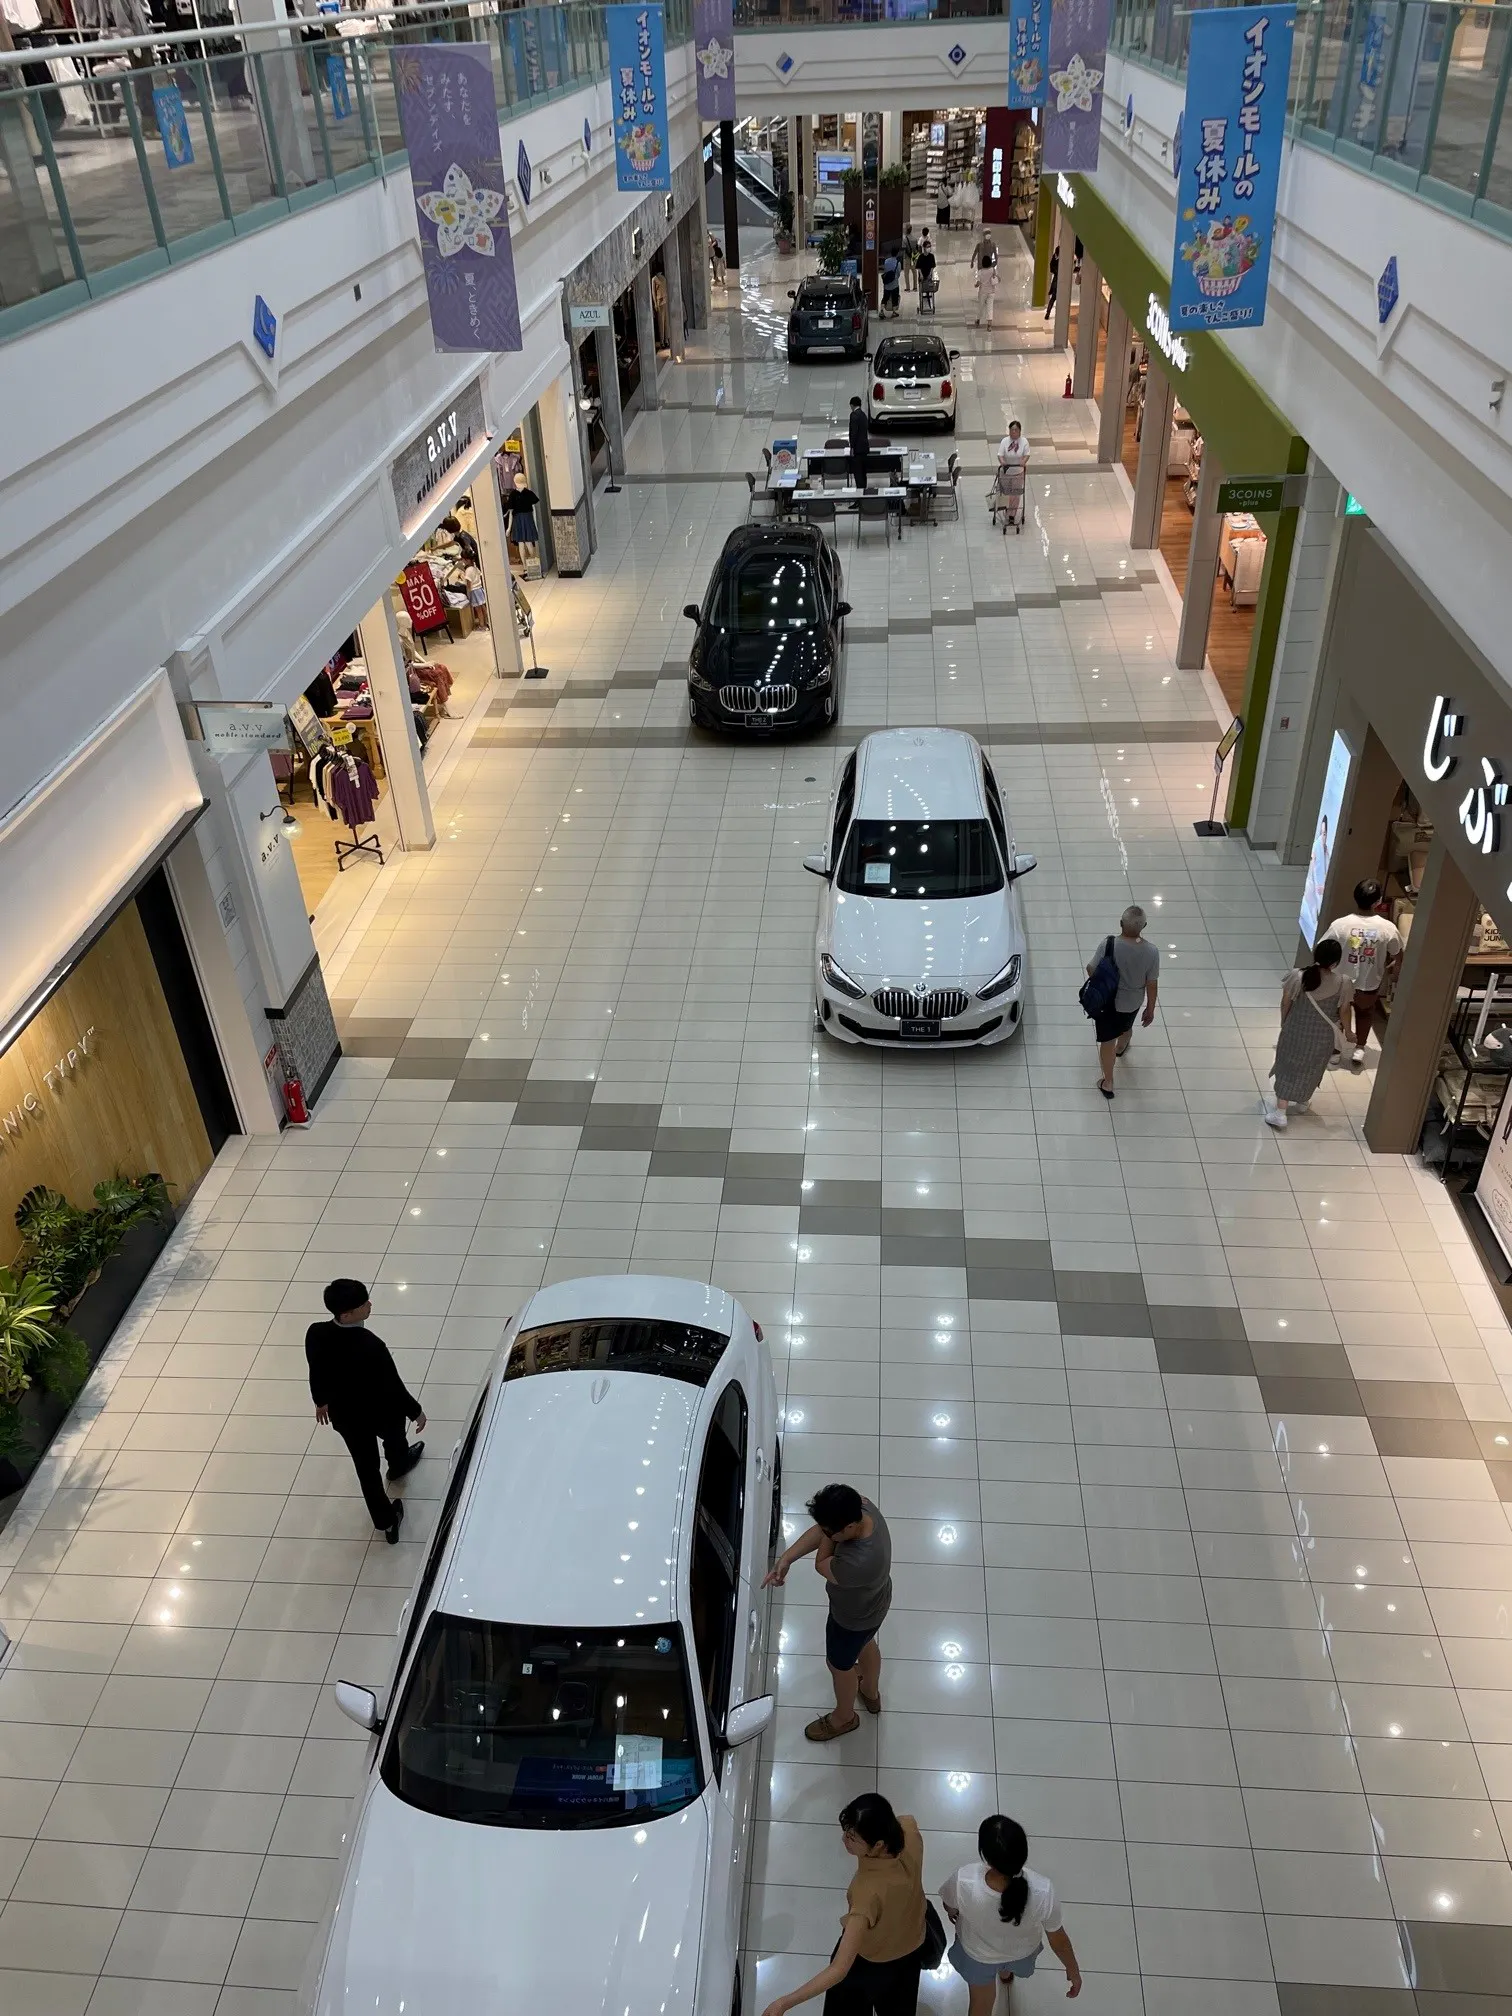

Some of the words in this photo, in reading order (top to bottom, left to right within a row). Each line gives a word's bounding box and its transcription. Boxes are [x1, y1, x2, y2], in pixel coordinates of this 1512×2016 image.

[637, 11, 655, 114] イオンモールの
[458, 73, 471, 126] あなたを
[620, 68, 637, 121] 夏休み
[1233, 17, 1269, 198] イオンモールの
[1195, 119, 1227, 213] 夏休み
[464, 272, 480, 339] 夏、ときめく
[580, 310, 600, 319] AZUL
[1181, 301, 1224, 317] 夏の楽しさ
[427, 412, 457, 462] a.v.v
[1229, 489, 1273, 499] 3COINS
[407, 574, 425, 587] MAX
[409, 584, 434, 610] 50
[416, 606, 437, 620] %OFF
[262, 834, 279, 862] a.v.v
